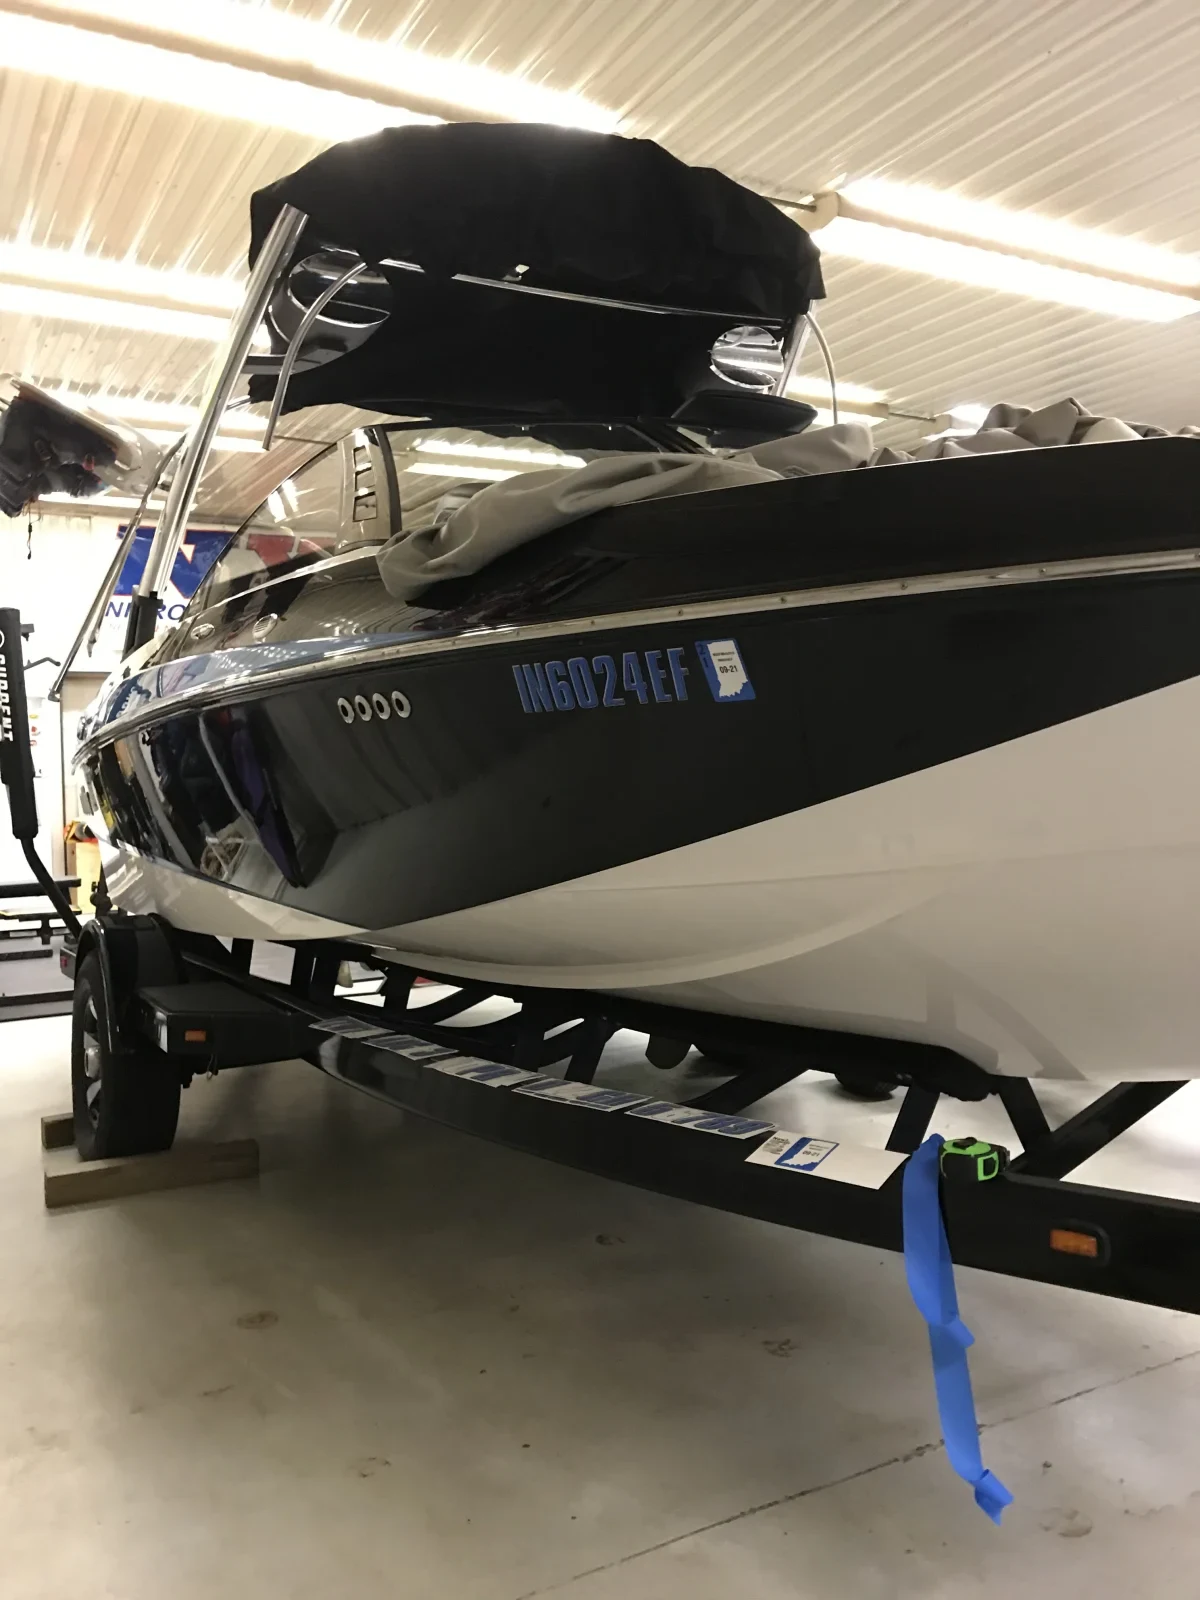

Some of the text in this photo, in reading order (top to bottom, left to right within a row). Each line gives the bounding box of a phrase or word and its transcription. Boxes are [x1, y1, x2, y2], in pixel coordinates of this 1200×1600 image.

[105, 601, 186, 621] NIRO
[719, 664, 738, 674] 09-21
[512, 647, 690, 713] IN6024EF
